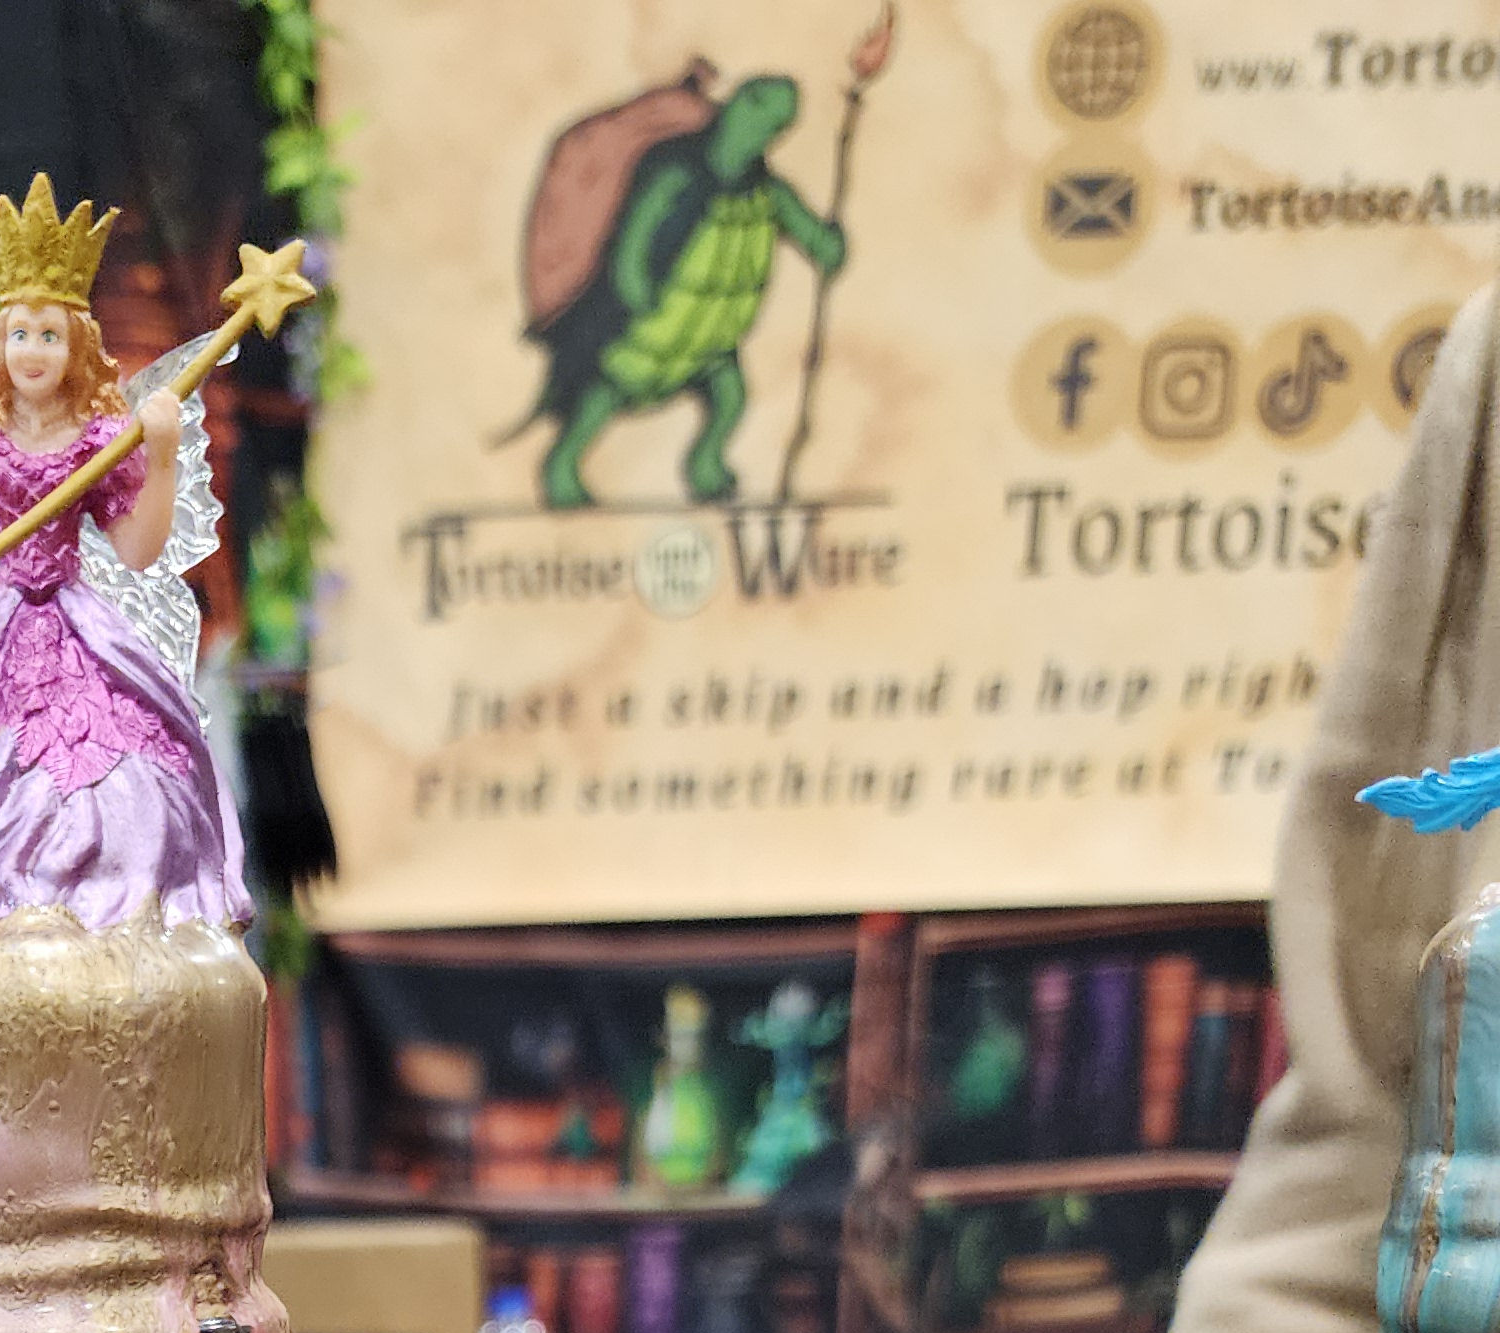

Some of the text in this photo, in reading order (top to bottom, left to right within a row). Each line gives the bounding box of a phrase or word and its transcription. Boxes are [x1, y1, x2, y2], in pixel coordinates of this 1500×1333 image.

[724, 500, 906, 600] Ware
[665, 670, 802, 735] skip
[828, 660, 954, 722] and
[1034, 655, 1153, 724] hop
[577, 748, 922, 817] something
[950, 754, 1094, 802] rare
